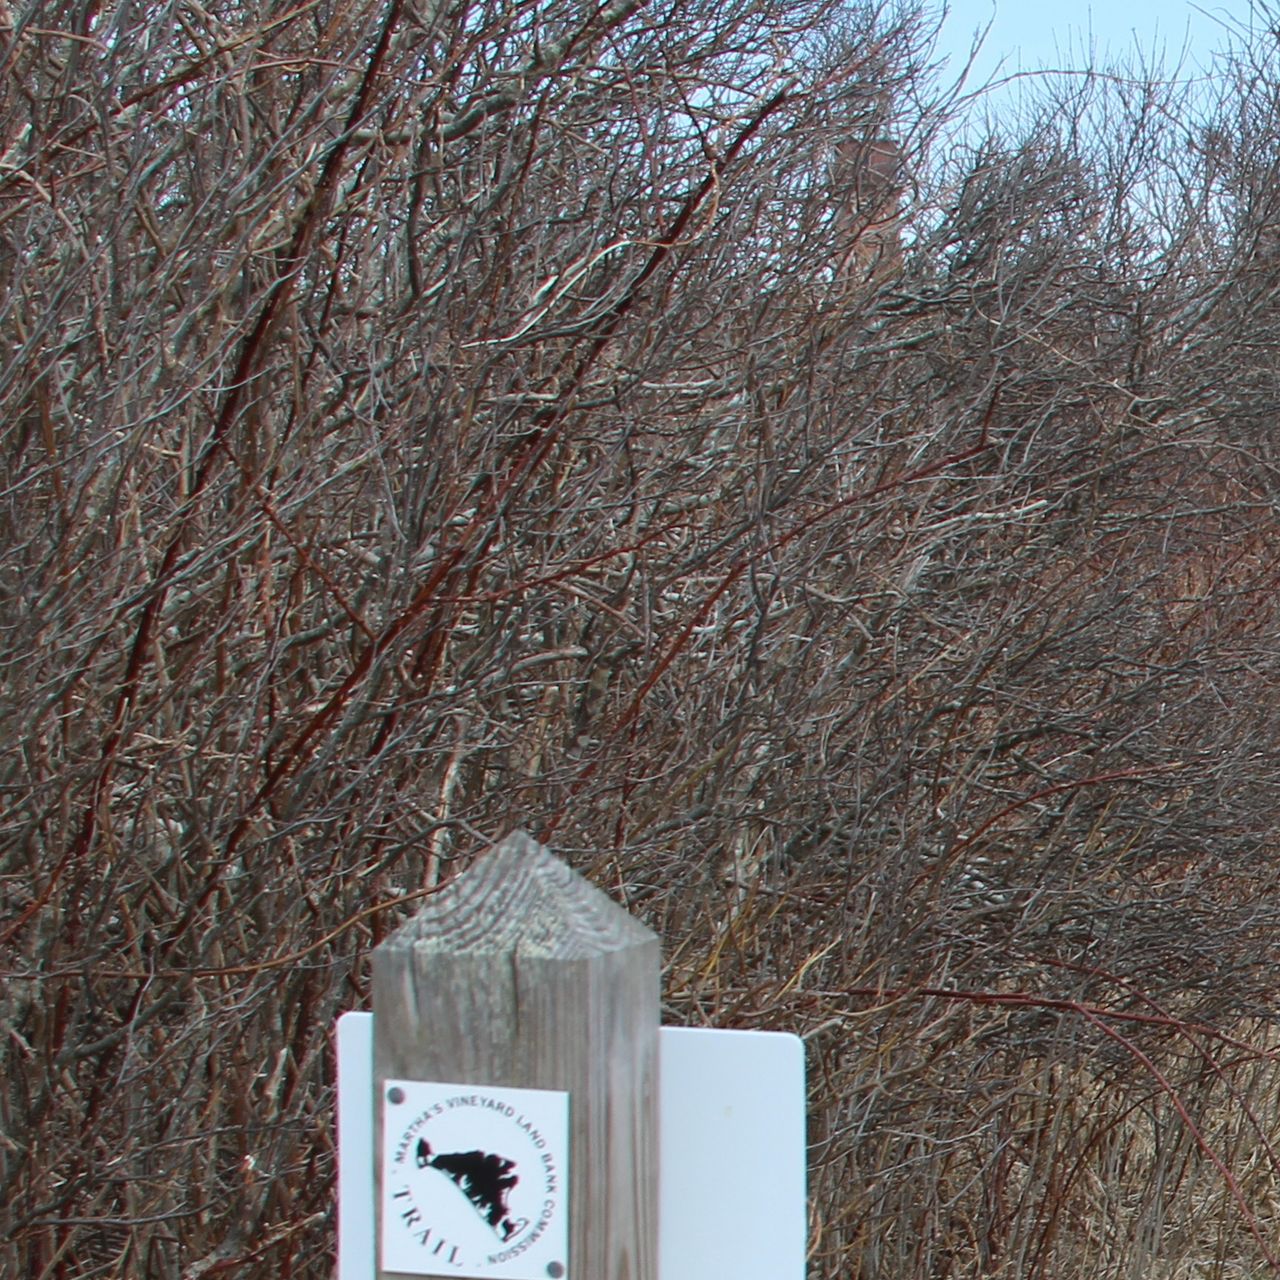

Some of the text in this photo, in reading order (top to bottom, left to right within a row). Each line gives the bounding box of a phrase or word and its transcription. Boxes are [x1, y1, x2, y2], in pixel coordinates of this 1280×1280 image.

[393, 1185, 464, 1267] TRAIL
[394, 1095, 556, 1265] MARTHA'S VINEYARD LAND BANK COMMISSION
